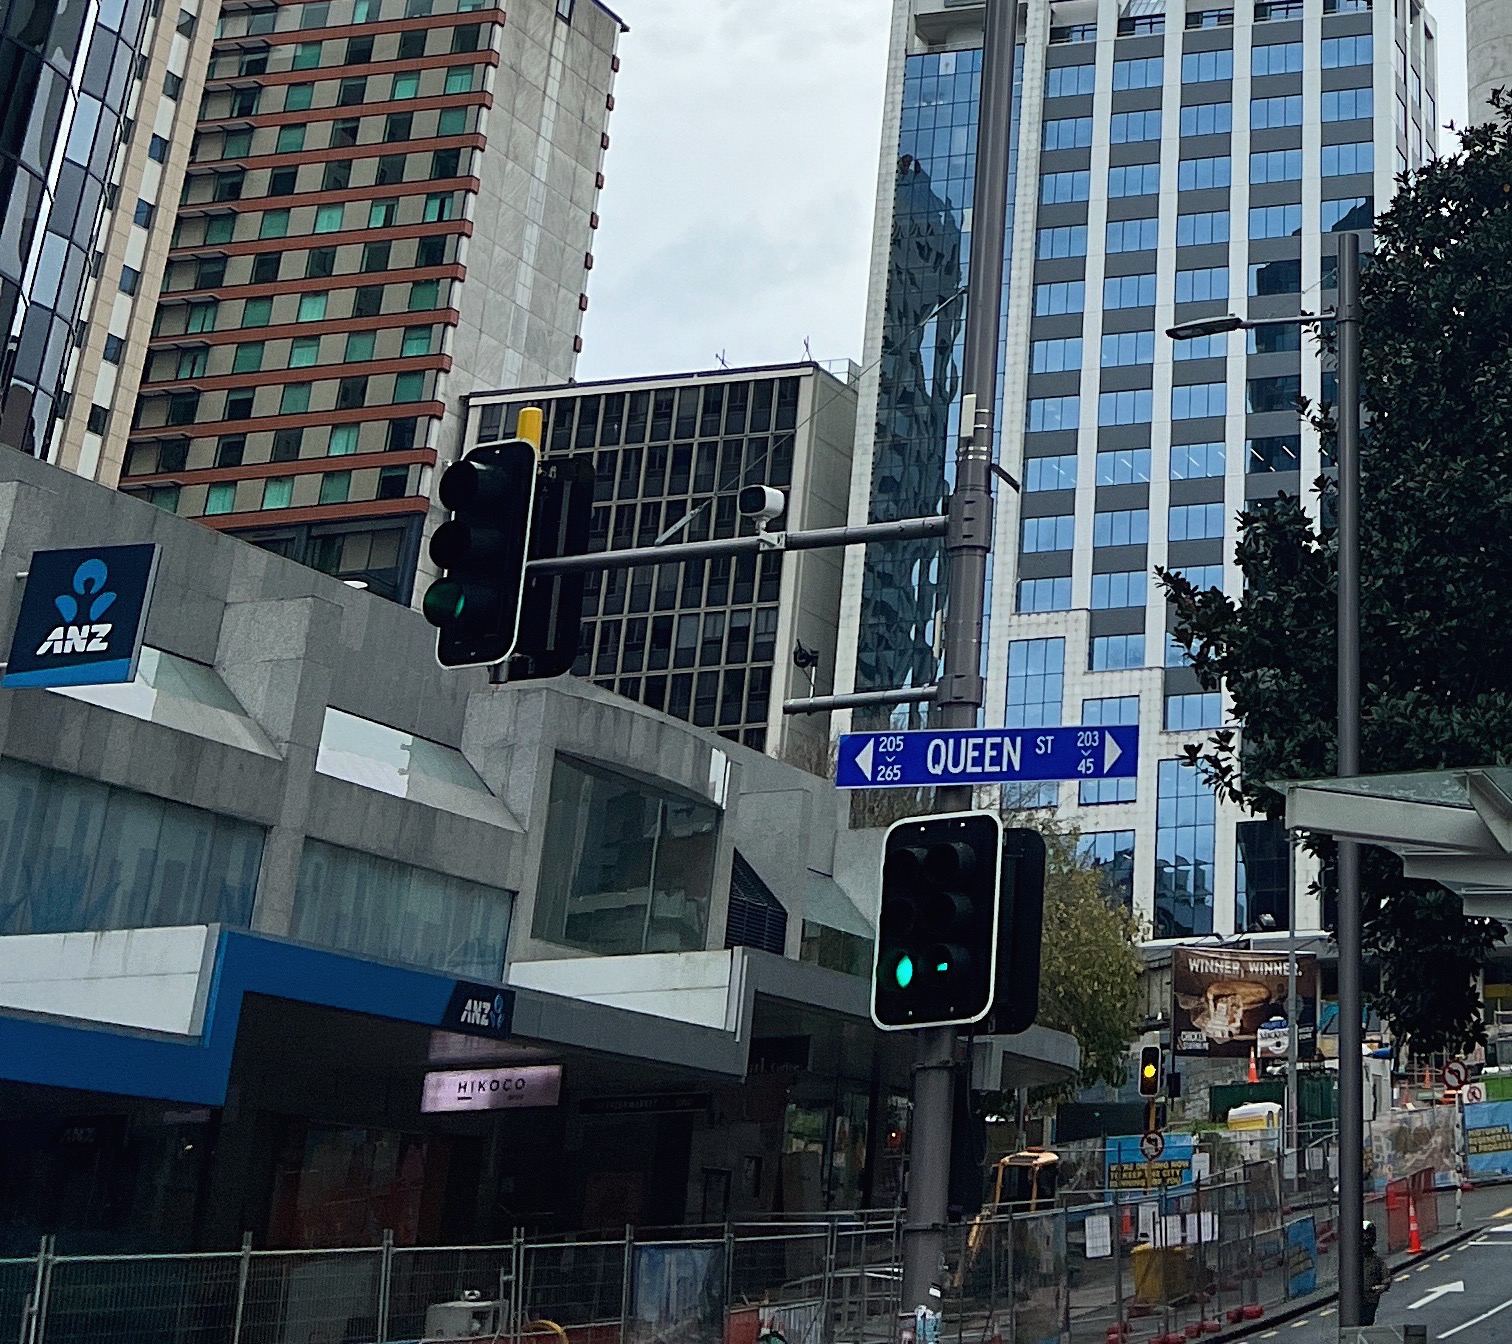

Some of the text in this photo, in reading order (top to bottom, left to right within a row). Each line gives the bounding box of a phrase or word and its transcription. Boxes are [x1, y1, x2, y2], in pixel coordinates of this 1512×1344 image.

[36, 623, 113, 656] ANZ
[878, 735, 904, 753] 205
[1076, 731, 1100, 747] 203
[926, 735, 1055, 775] QUEEN ST
[876, 764, 902, 781] 265
[1076, 758, 1095, 775] 45
[1188, 958, 1245, 978] WINNER,
[460, 998, 492, 1026] ANZ
[457, 1078, 526, 1094] HIKOCO
